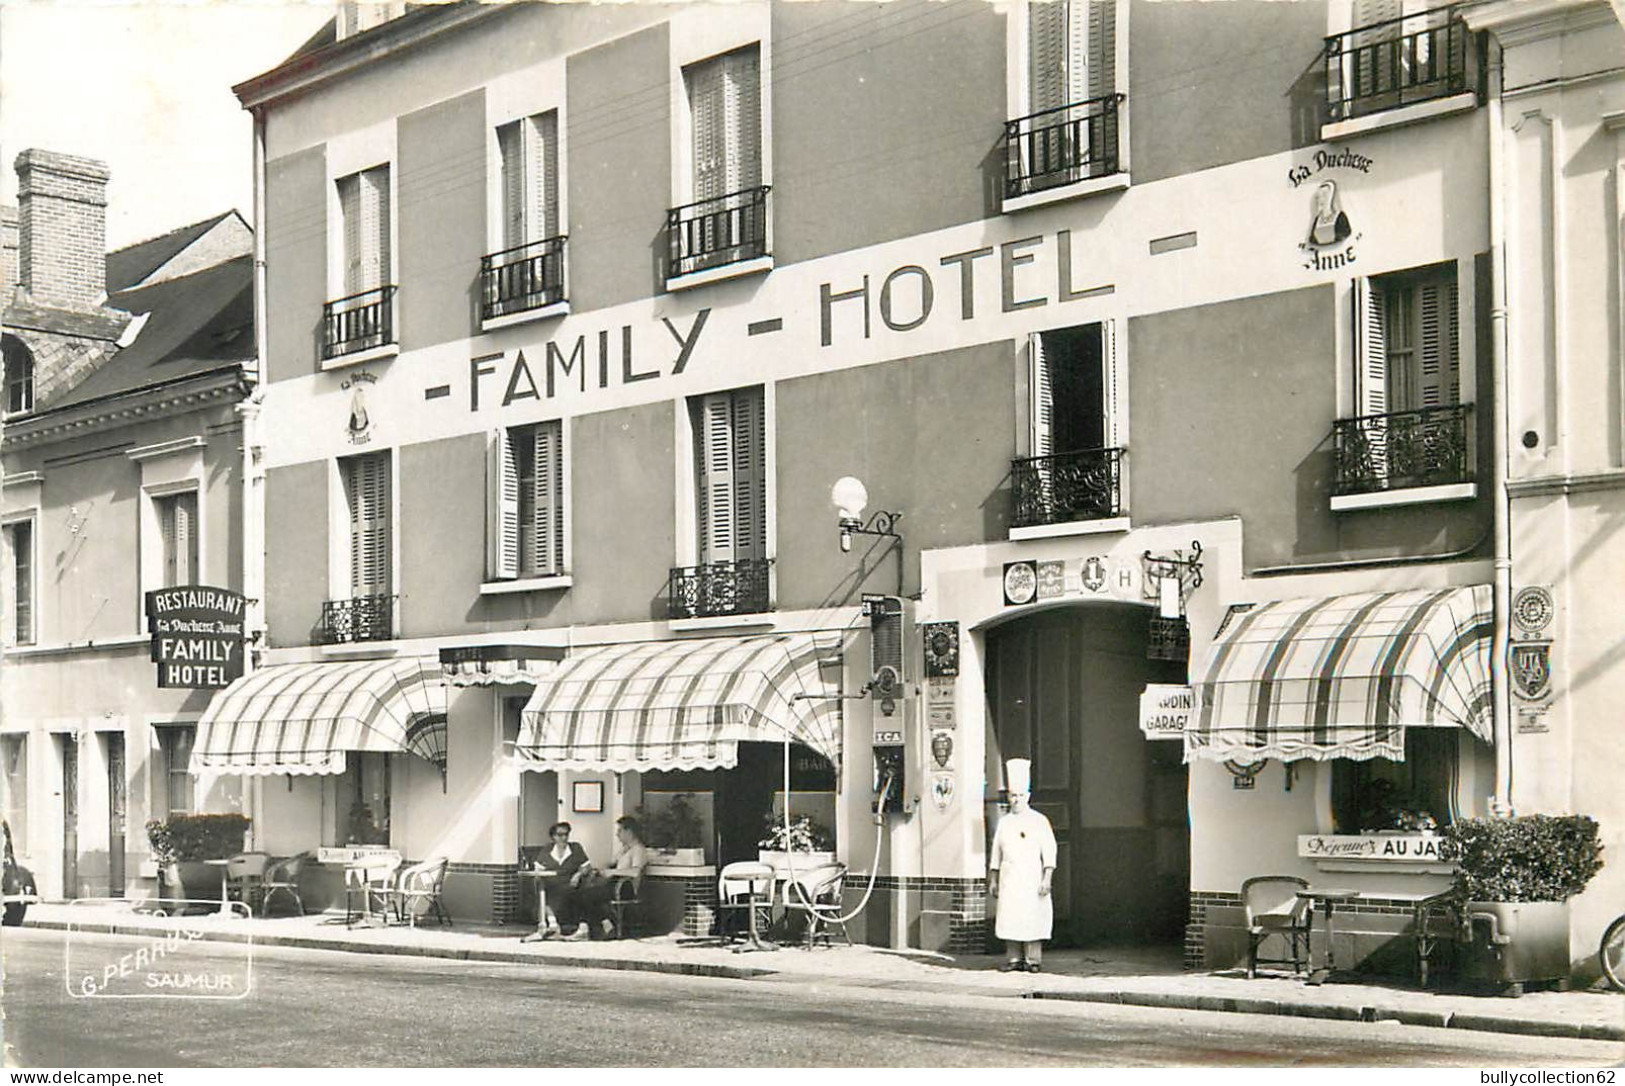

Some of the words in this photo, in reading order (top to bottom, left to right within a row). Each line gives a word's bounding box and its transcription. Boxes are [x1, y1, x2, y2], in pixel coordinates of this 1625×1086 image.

[470, 308, 712, 412] FAMILY
[820, 229, 1115, 346] HOTEL
[155, 590, 243, 615] RESTAURANT
[161, 638, 234, 661] FAMILY
[168, 665, 228, 685] HOTEL
[1383, 839, 1407, 856] AU
